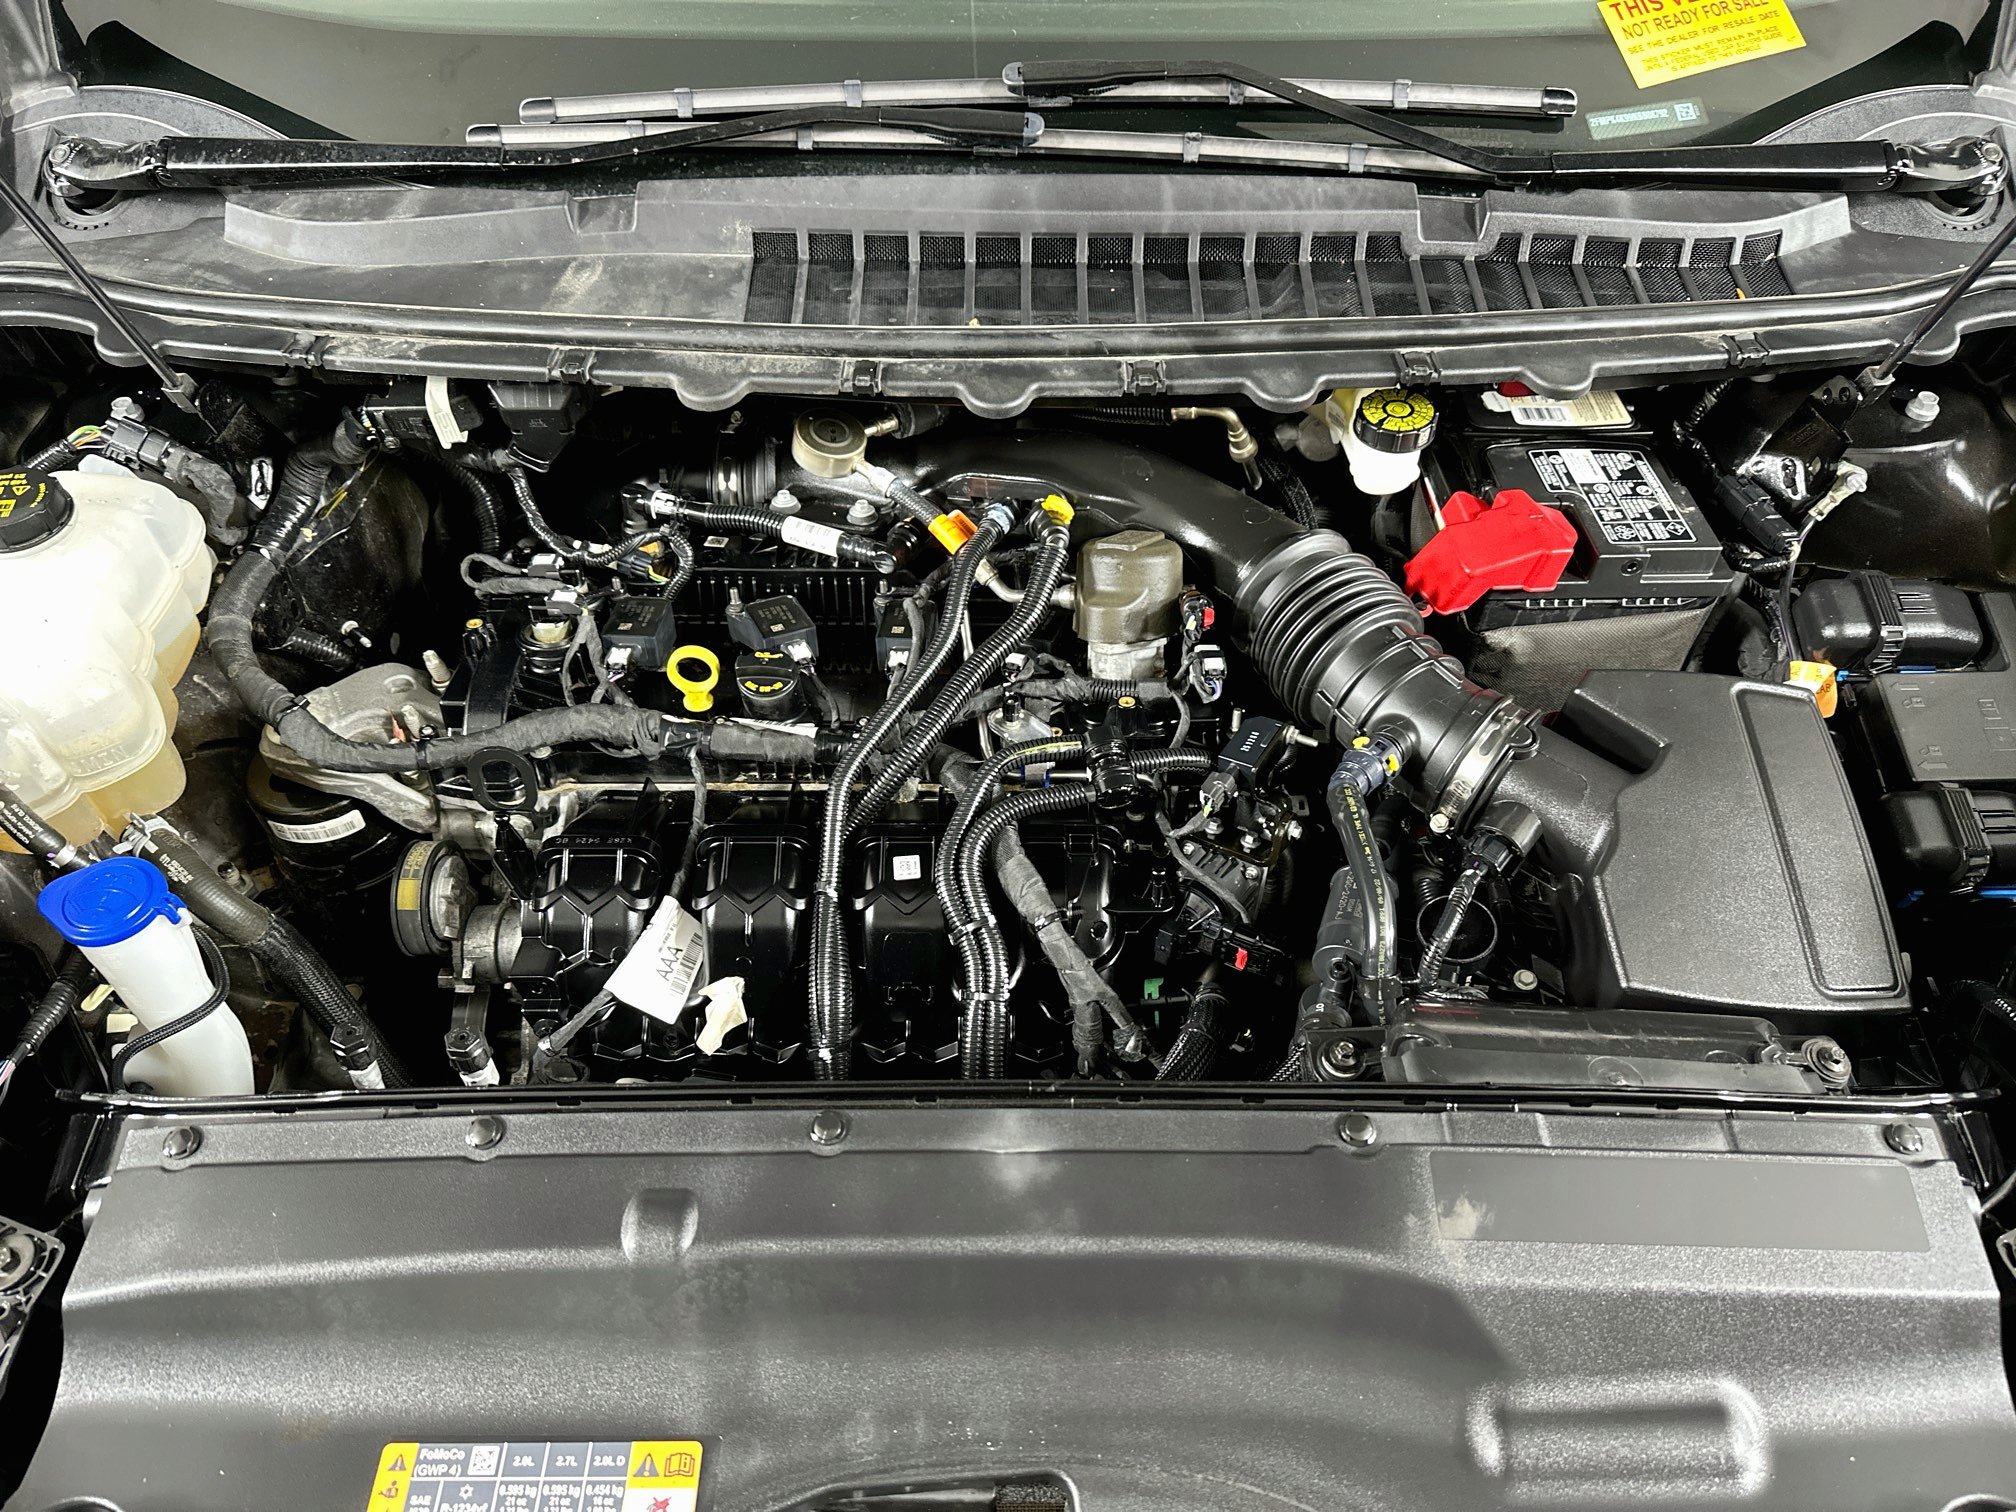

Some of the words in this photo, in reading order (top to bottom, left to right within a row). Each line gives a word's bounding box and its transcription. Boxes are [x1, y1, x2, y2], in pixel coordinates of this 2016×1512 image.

[1609, 0, 1664, 20] THIS
[1621, 20, 1651, 40] NOT
[1653, 8, 1700, 32] READY
[1701, 1, 1732, 19] FOR
[1628, 45, 1645, 54] SEE
[1647, 40, 1664, 48] THE
[1666, 30, 1699, 44] DEALER
[1702, 25, 1719, 34] FOR
[1722, 16, 1756, 29] RESALE
[1758, 10, 1780, 21] DATE
[656, 946, 683, 982] AAA
[420, 1448, 466, 1460] FoMoCo
[512, 1455, 535, 1467] 2.0L
[555, 1455, 578, 1467] 2.7L
[616, 1455, 626, 1467] D
[525, 1484, 538, 1498] kg
[568, 1484, 581, 1498] kg
[611, 1484, 624, 1498] kg
